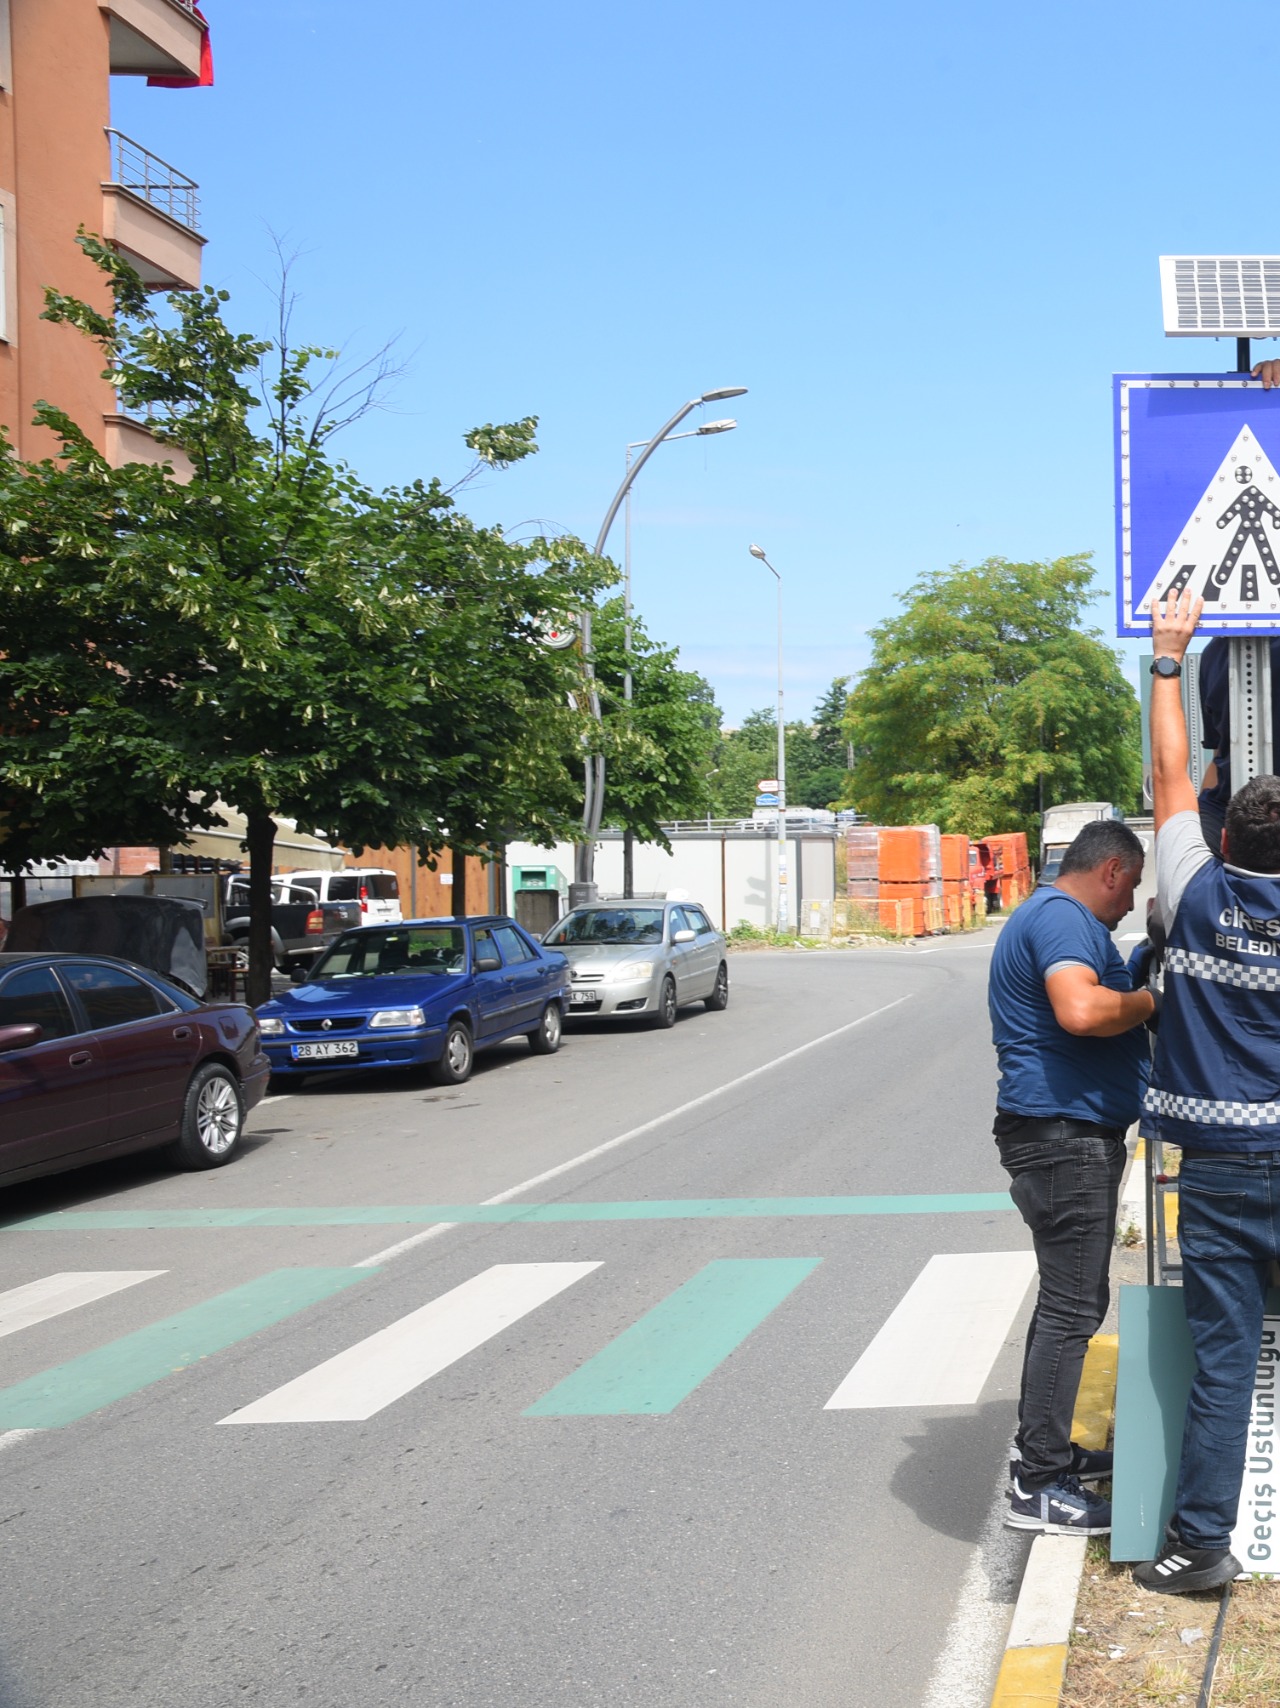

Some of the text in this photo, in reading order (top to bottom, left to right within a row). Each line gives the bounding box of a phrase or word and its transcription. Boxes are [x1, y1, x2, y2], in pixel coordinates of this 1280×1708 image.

[581, 992, 594, 1001] 759
[298, 1042, 356, 1056] 28 AY 362
[1247, 1483, 1277, 1561] Geçiş
